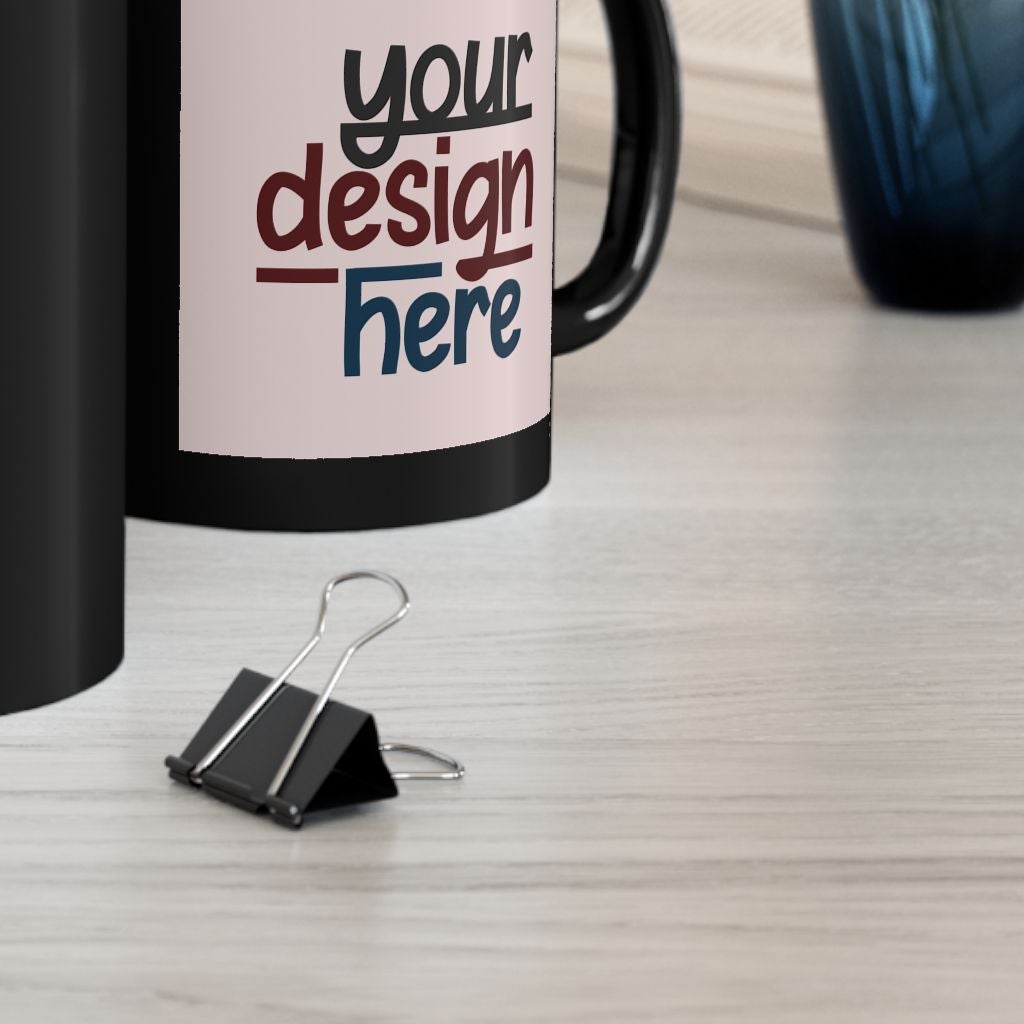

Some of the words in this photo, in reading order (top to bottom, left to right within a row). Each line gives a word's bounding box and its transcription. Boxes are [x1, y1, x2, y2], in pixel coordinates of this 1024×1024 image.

[340, 31, 533, 169] your
[256, 136, 534, 282] design
[343, 262, 522, 377] here
